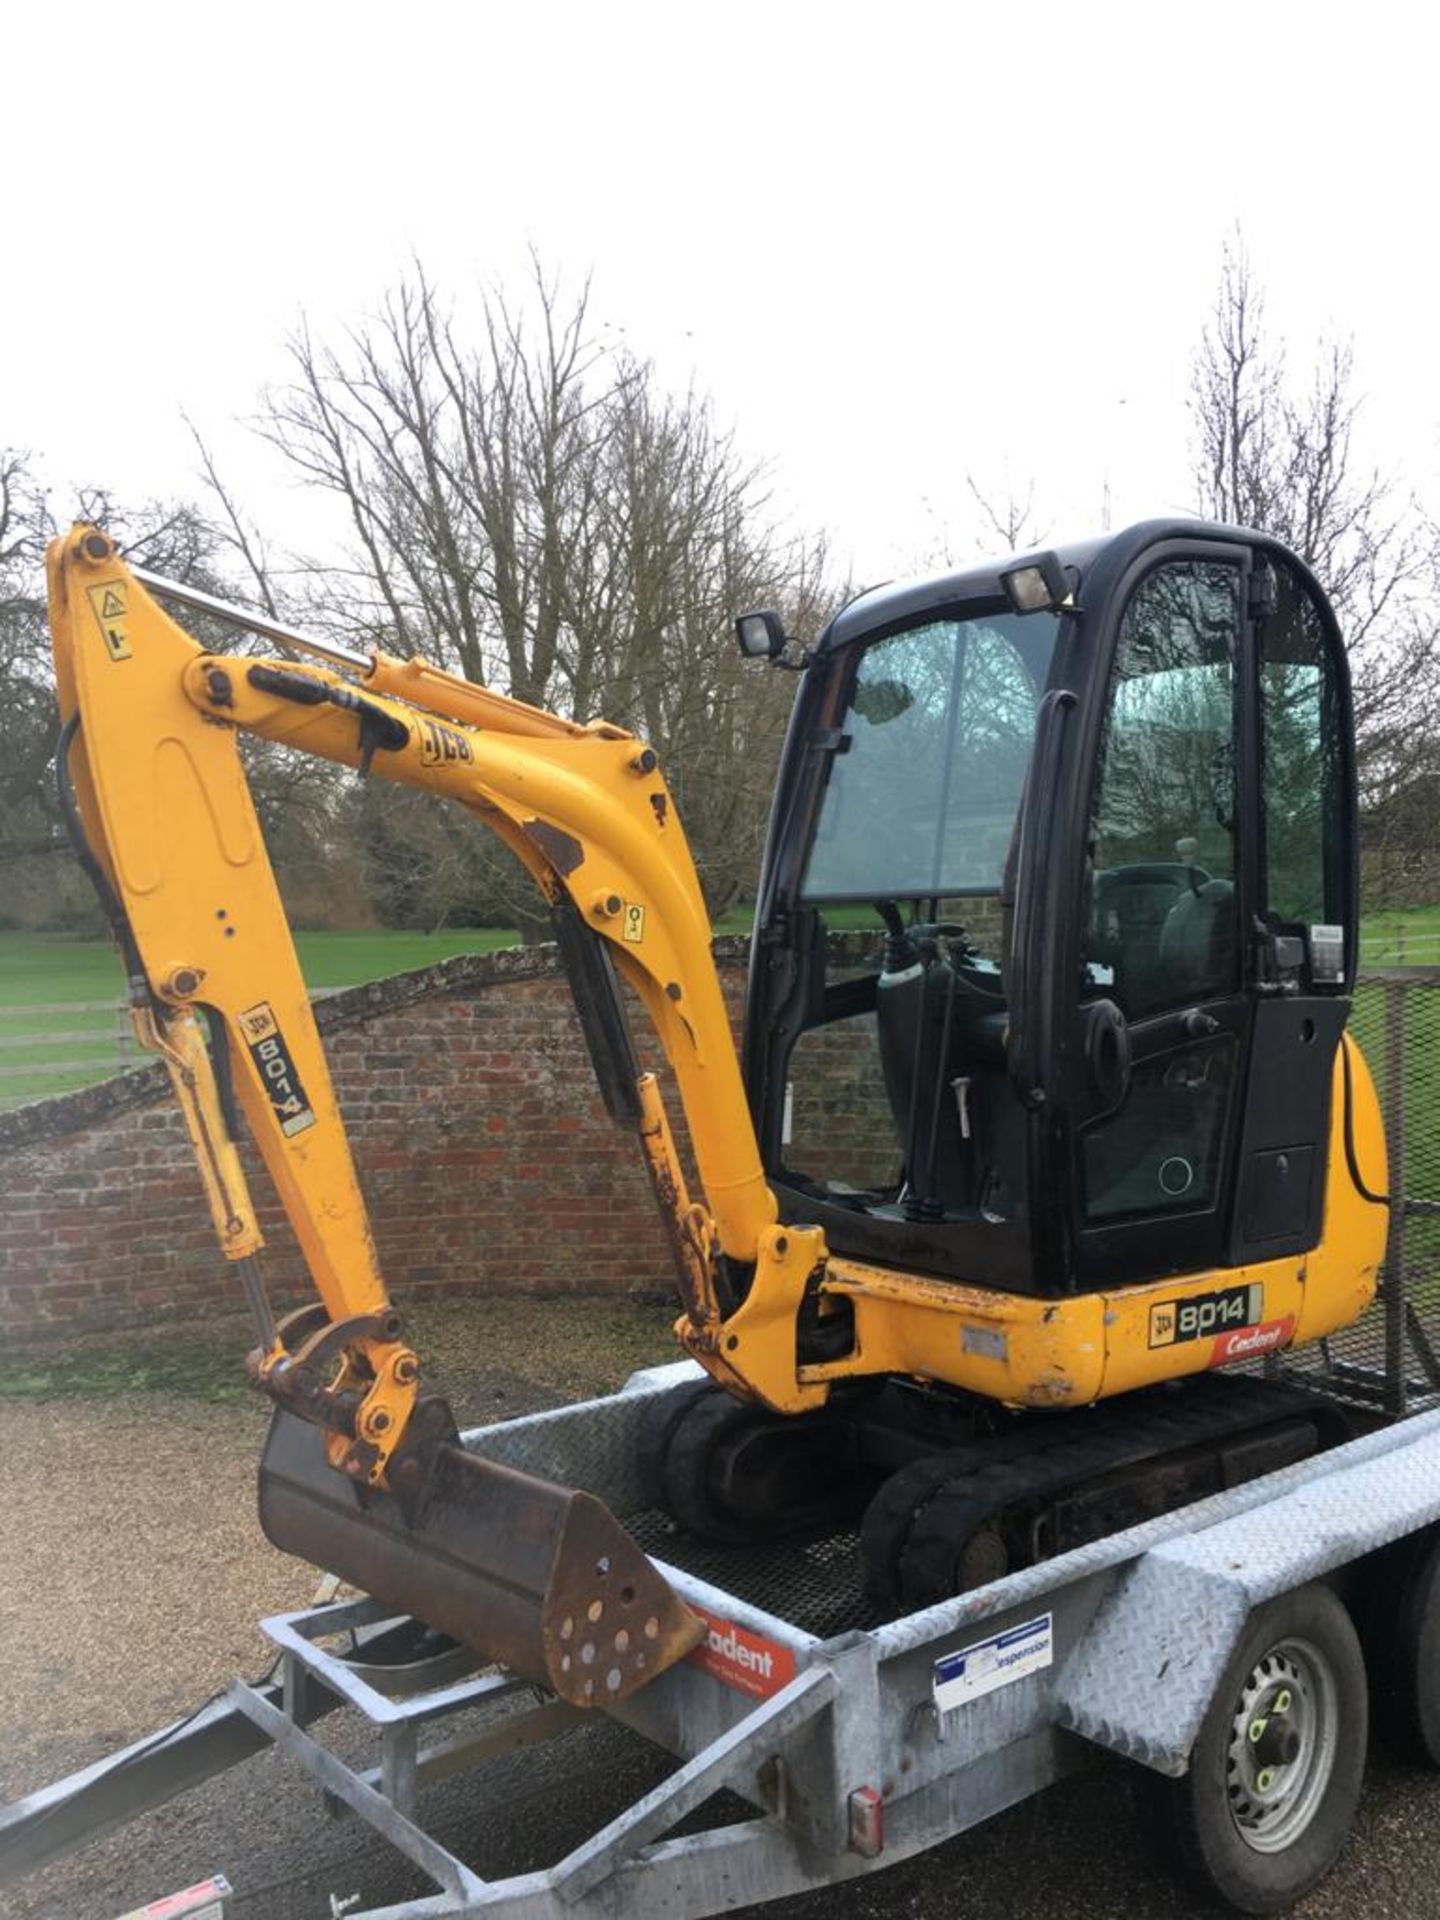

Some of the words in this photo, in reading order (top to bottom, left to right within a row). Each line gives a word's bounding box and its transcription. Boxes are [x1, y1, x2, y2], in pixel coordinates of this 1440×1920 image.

[423, 719, 470, 761] JCB
[258, 1039, 302, 1114] 8014
[1179, 1295, 1245, 1333] 8014
[1226, 1326, 1281, 1355] Cadent
[704, 1629, 773, 1679] adent
[996, 1638, 1050, 1668] espension
